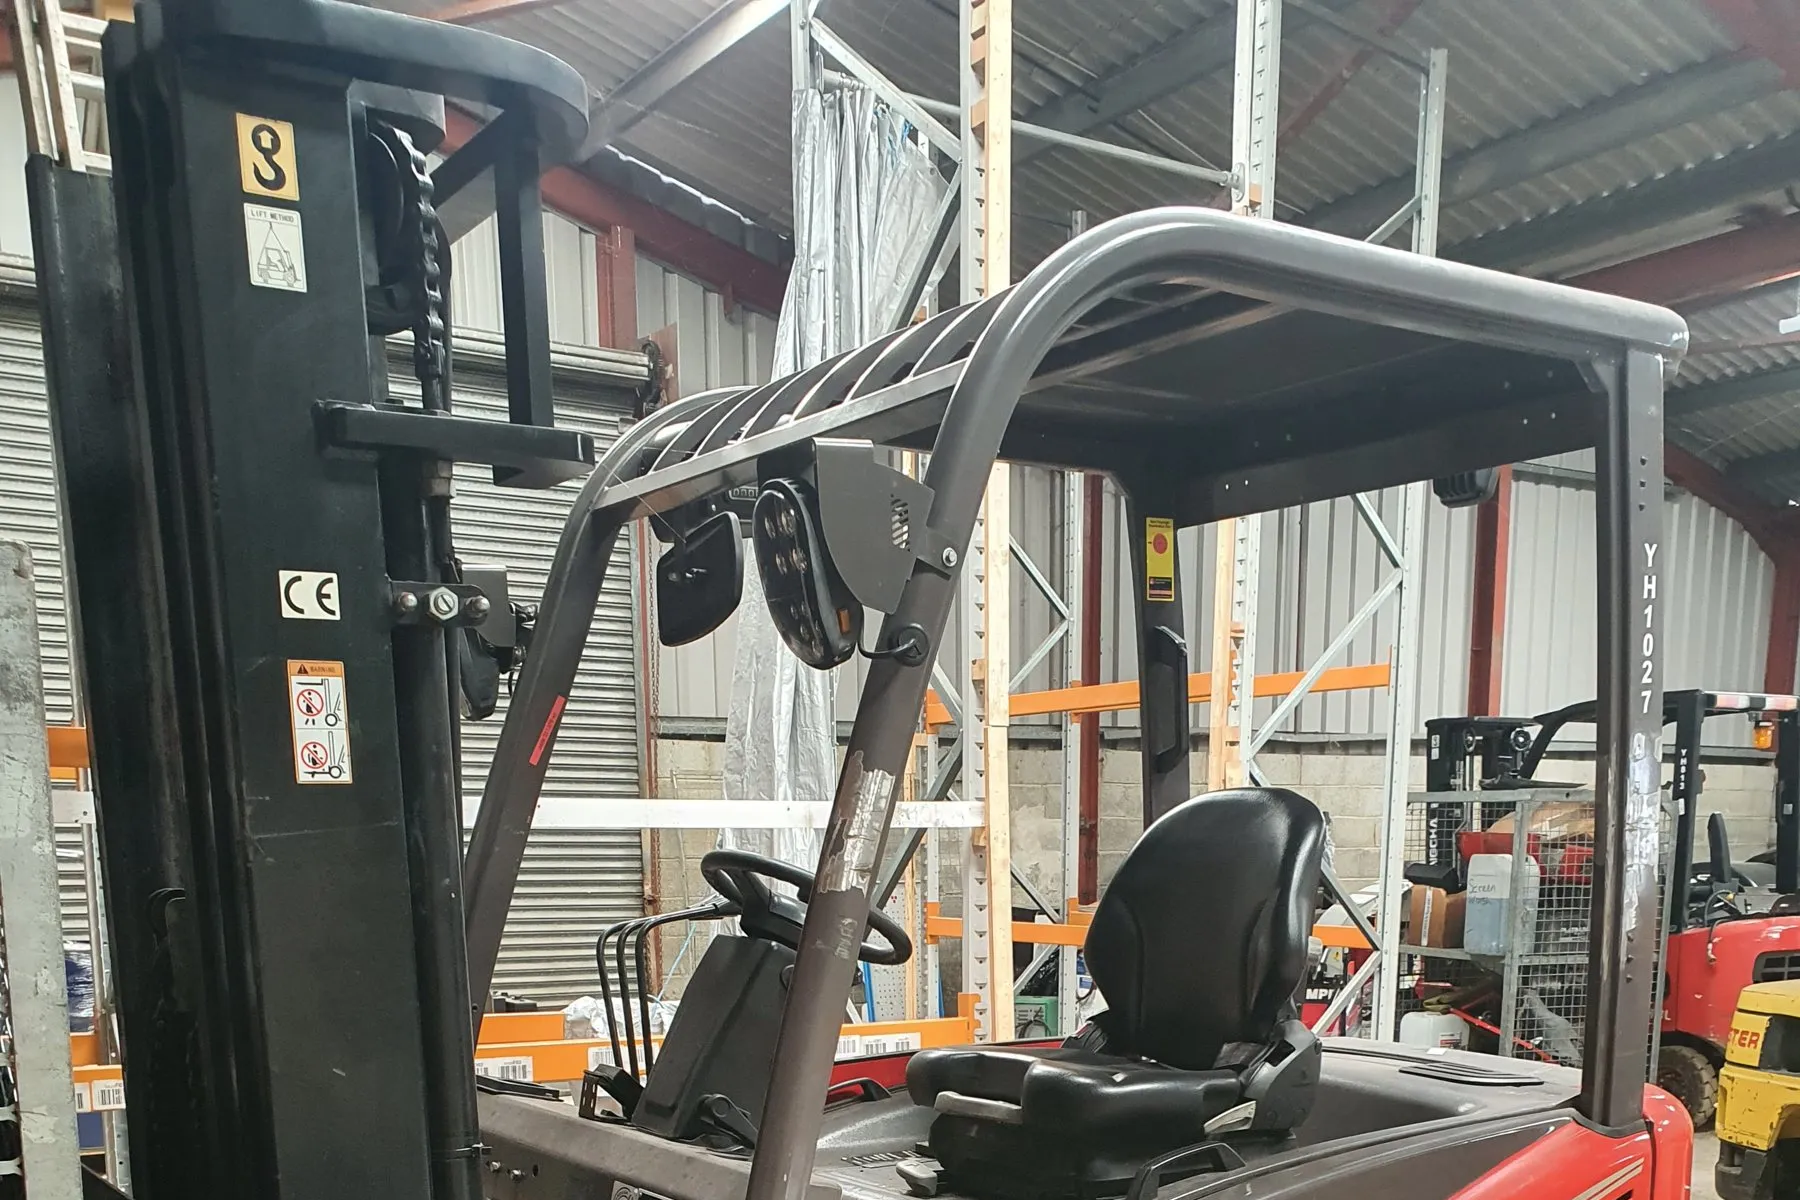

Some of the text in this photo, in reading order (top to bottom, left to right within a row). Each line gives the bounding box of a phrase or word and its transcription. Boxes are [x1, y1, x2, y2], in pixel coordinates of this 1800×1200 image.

[251, 209, 294, 222] LIFT METHOD
[284, 575, 337, 616] CE
[1640, 543, 1658, 714] YH1027
